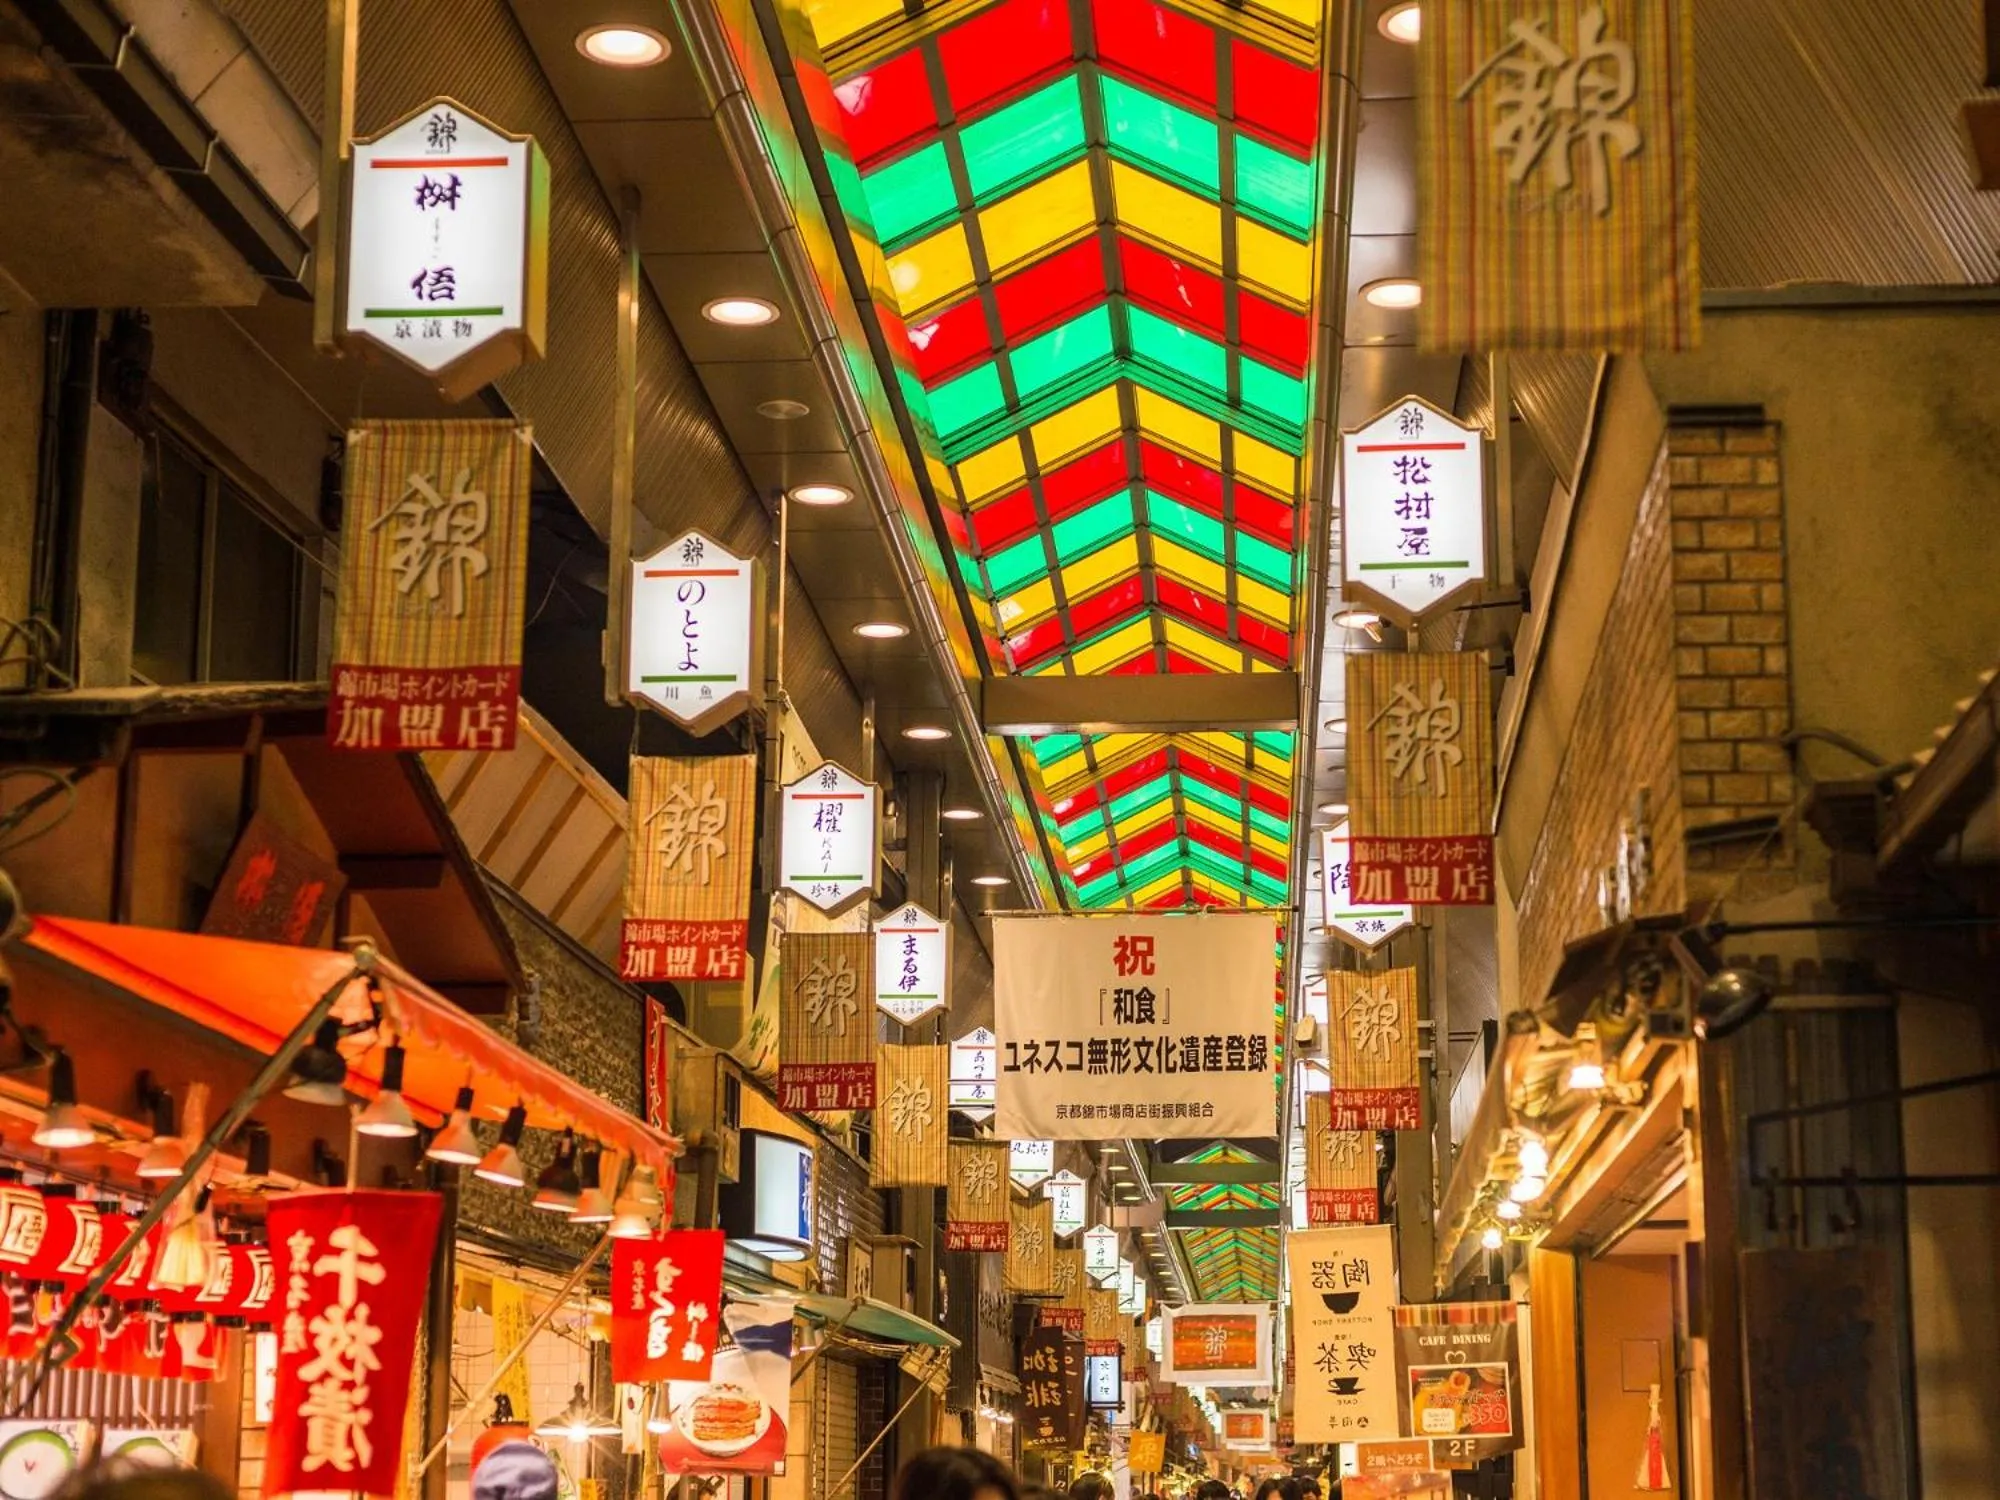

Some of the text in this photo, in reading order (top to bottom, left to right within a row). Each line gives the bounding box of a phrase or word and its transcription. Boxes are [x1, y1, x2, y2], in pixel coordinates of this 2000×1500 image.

[1457, 5, 1643, 218] 錦
[421, 112, 457, 153] 錦
[394, 319, 473, 339] 京漬物
[1395, 407, 1424, 439] 錦
[1393, 455, 1434, 556] 松村屋
[368, 467, 490, 619] 錦
[676, 579, 706, 672] のとよ
[332, 700, 508, 747] 加盟店
[1367, 678, 1465, 798] 錦
[643, 779, 728, 886] 錦
[821, 838, 833, 874] KAI
[811, 883, 842, 898] 珍味
[1354, 864, 1489, 901] 加盟店
[622, 945, 740, 978] 加盟店
[899, 934, 921, 993] まる伊
[1113, 935, 1156, 977] 祝
[794, 953, 858, 1037] 錦
[1100, 986, 1170, 1025] 『和食』
[1340, 984, 1400, 1063] 錦
[1003, 1034, 1269, 1075] ユネスコ無形文化遺産登録
[782, 1082, 872, 1108] 加盟店
[879, 1074, 933, 1143] 錦
[1056, 1102, 1215, 1121] 京都錦市場商店街振興組合
[1335, 1107, 1418, 1129] 加盟店
[956, 1153, 999, 1204] 錦
[1310, 1203, 1376, 1224] 加盟店
[949, 1235, 1007, 1250] 加盟店
[1419, 1333, 1491, 1346] CAFE DINING
[1450, 1440, 1475, 1456] 2F
